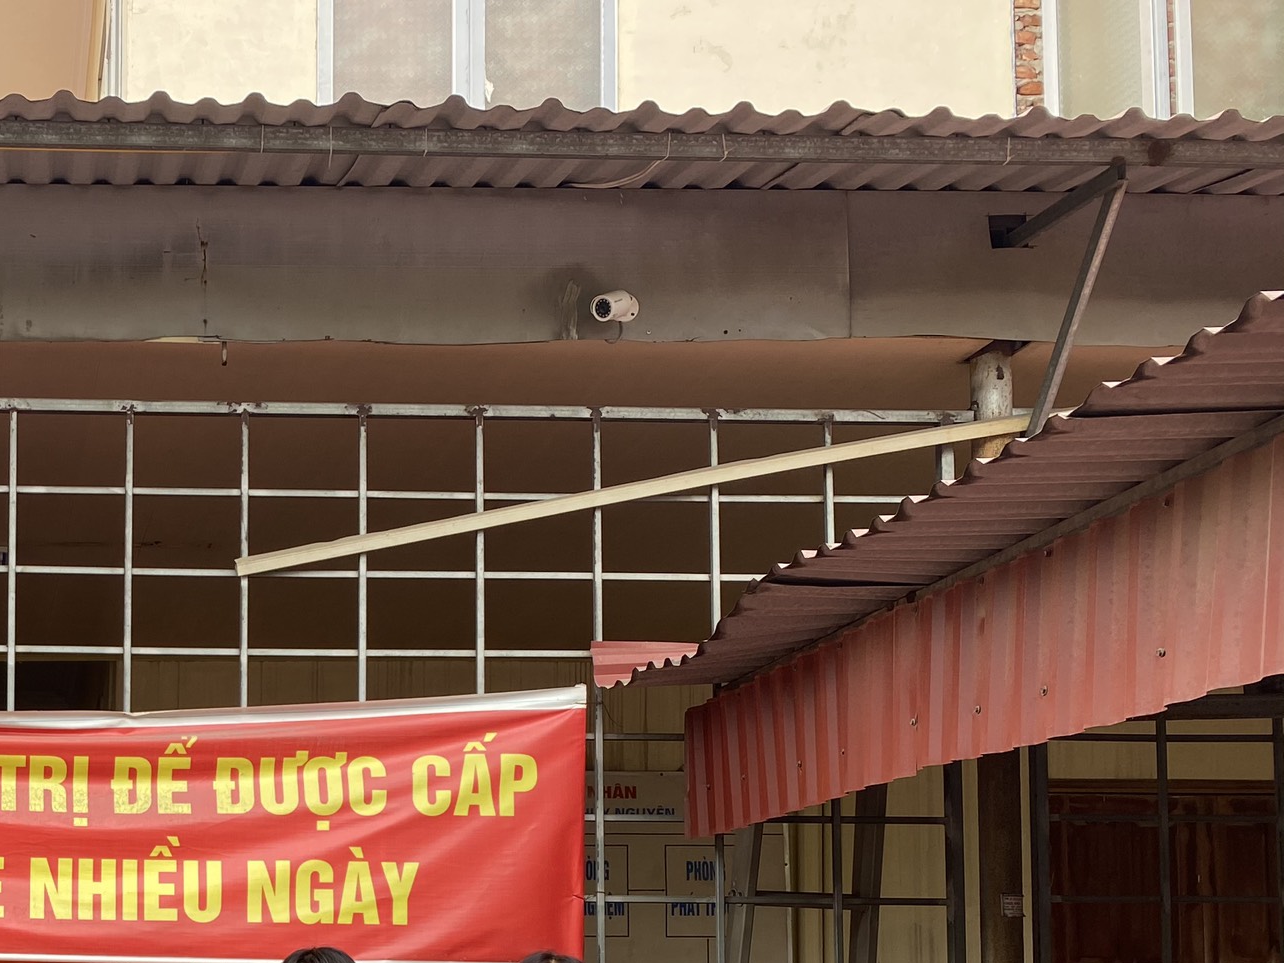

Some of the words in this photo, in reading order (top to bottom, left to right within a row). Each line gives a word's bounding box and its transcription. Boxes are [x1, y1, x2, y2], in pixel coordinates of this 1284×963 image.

[213, 750, 388, 831] ĐƯỢC
[412, 732, 538, 817] CẤP
[29, 836, 222, 923] NHIỀU
[247, 846, 420, 926] NGÀY
[686, 856, 725, 881] PHÒN
